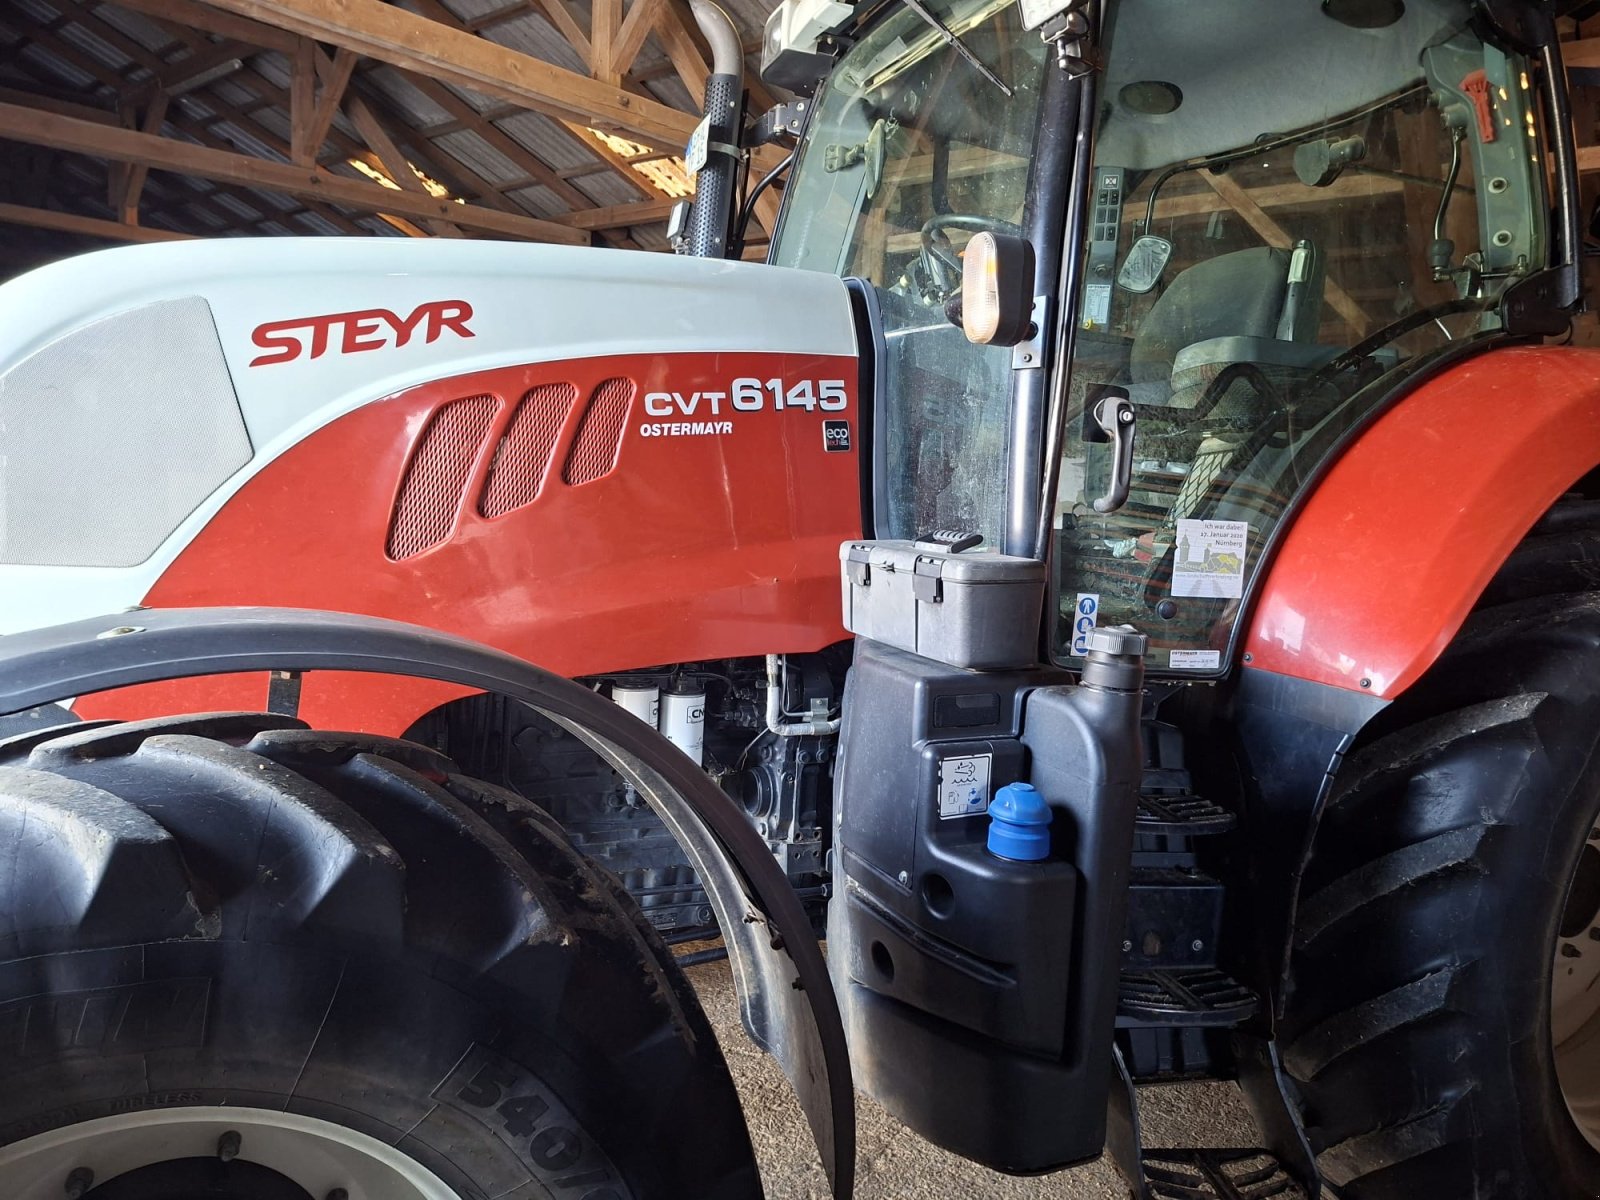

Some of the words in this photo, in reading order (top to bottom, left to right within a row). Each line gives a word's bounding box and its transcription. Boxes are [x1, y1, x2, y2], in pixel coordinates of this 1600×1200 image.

[248, 299, 476, 368] STEYR
[644, 392, 726, 417] CVT
[730, 377, 848, 413] 6145
[639, 421, 734, 437] OSTERMAYR
[826, 428, 848, 438] eco
[1215, 539, 1243, 548] Nürnberg
